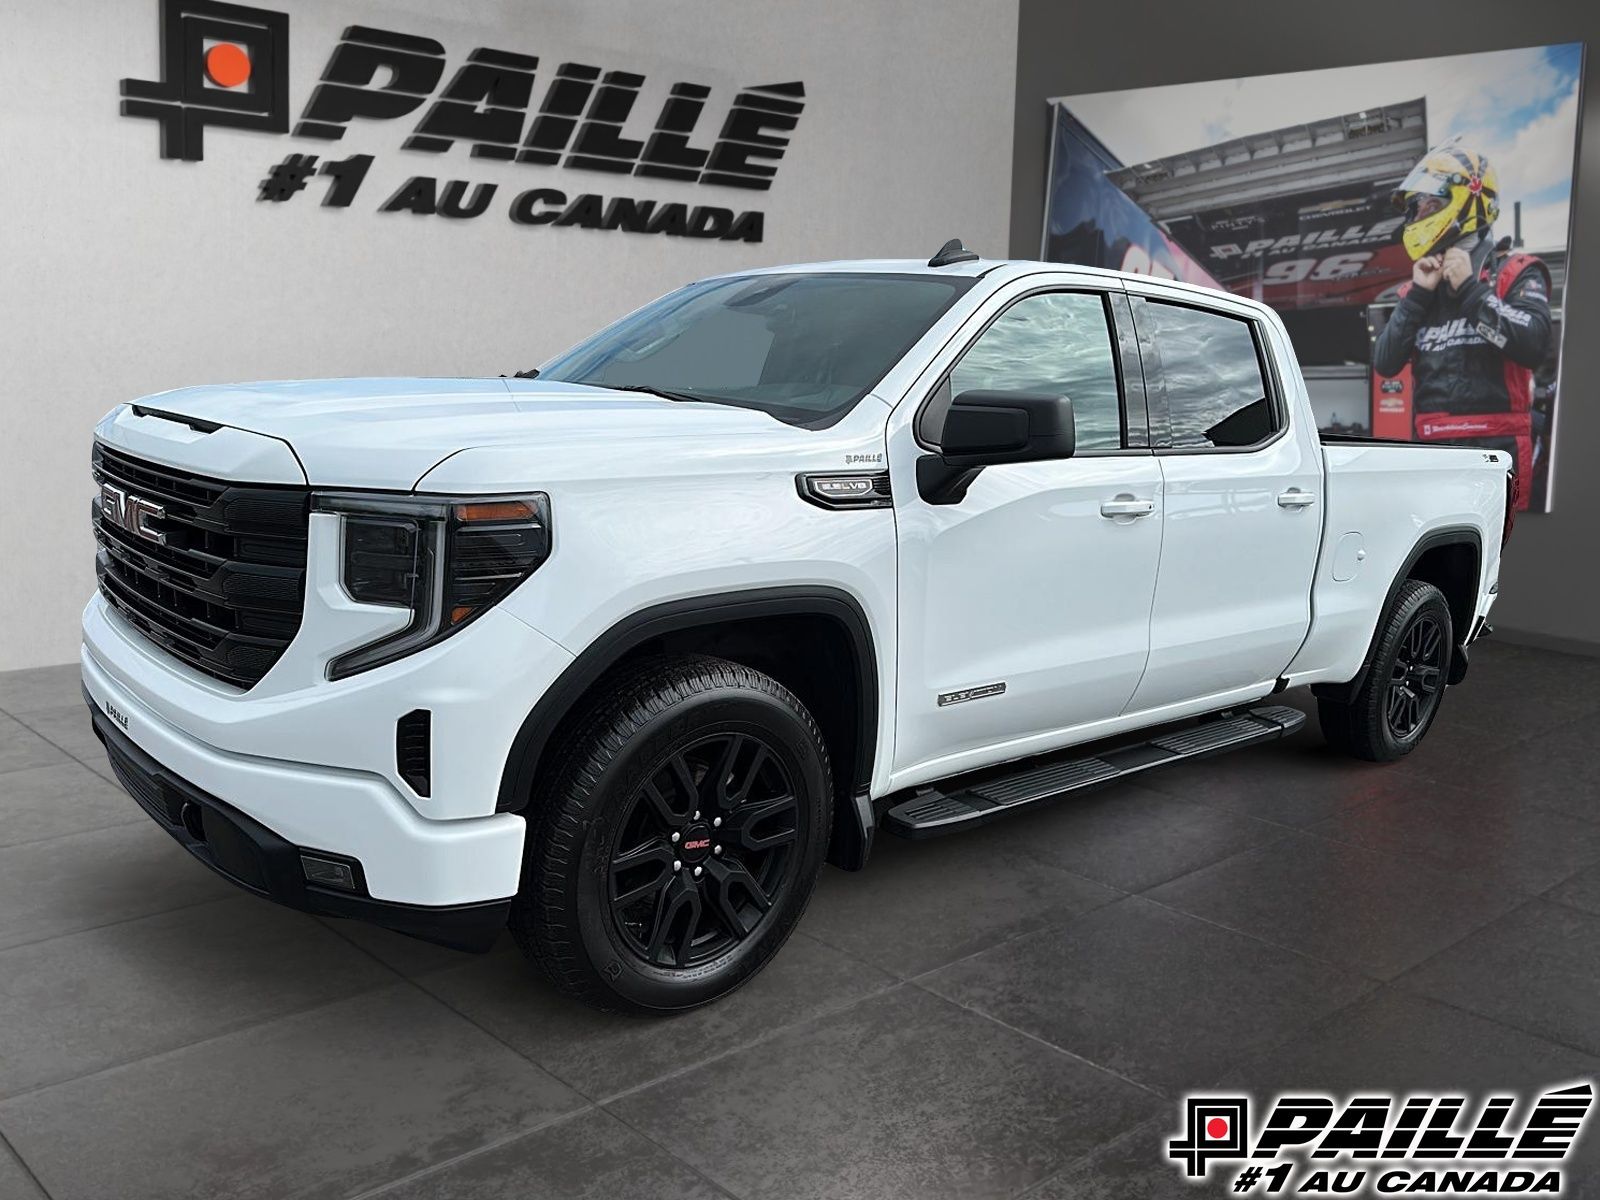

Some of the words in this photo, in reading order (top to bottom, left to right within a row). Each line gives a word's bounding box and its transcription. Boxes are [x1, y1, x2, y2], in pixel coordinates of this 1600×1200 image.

[290, 25, 806, 191] PAILLÉ
[256, 153, 375, 208] #1
[377, 176, 499, 219] AU
[509, 187, 765, 243] CANADA
[1261, 251, 1375, 286] 96
[101, 482, 167, 547] GMC
[684, 839, 711, 849] GMC
